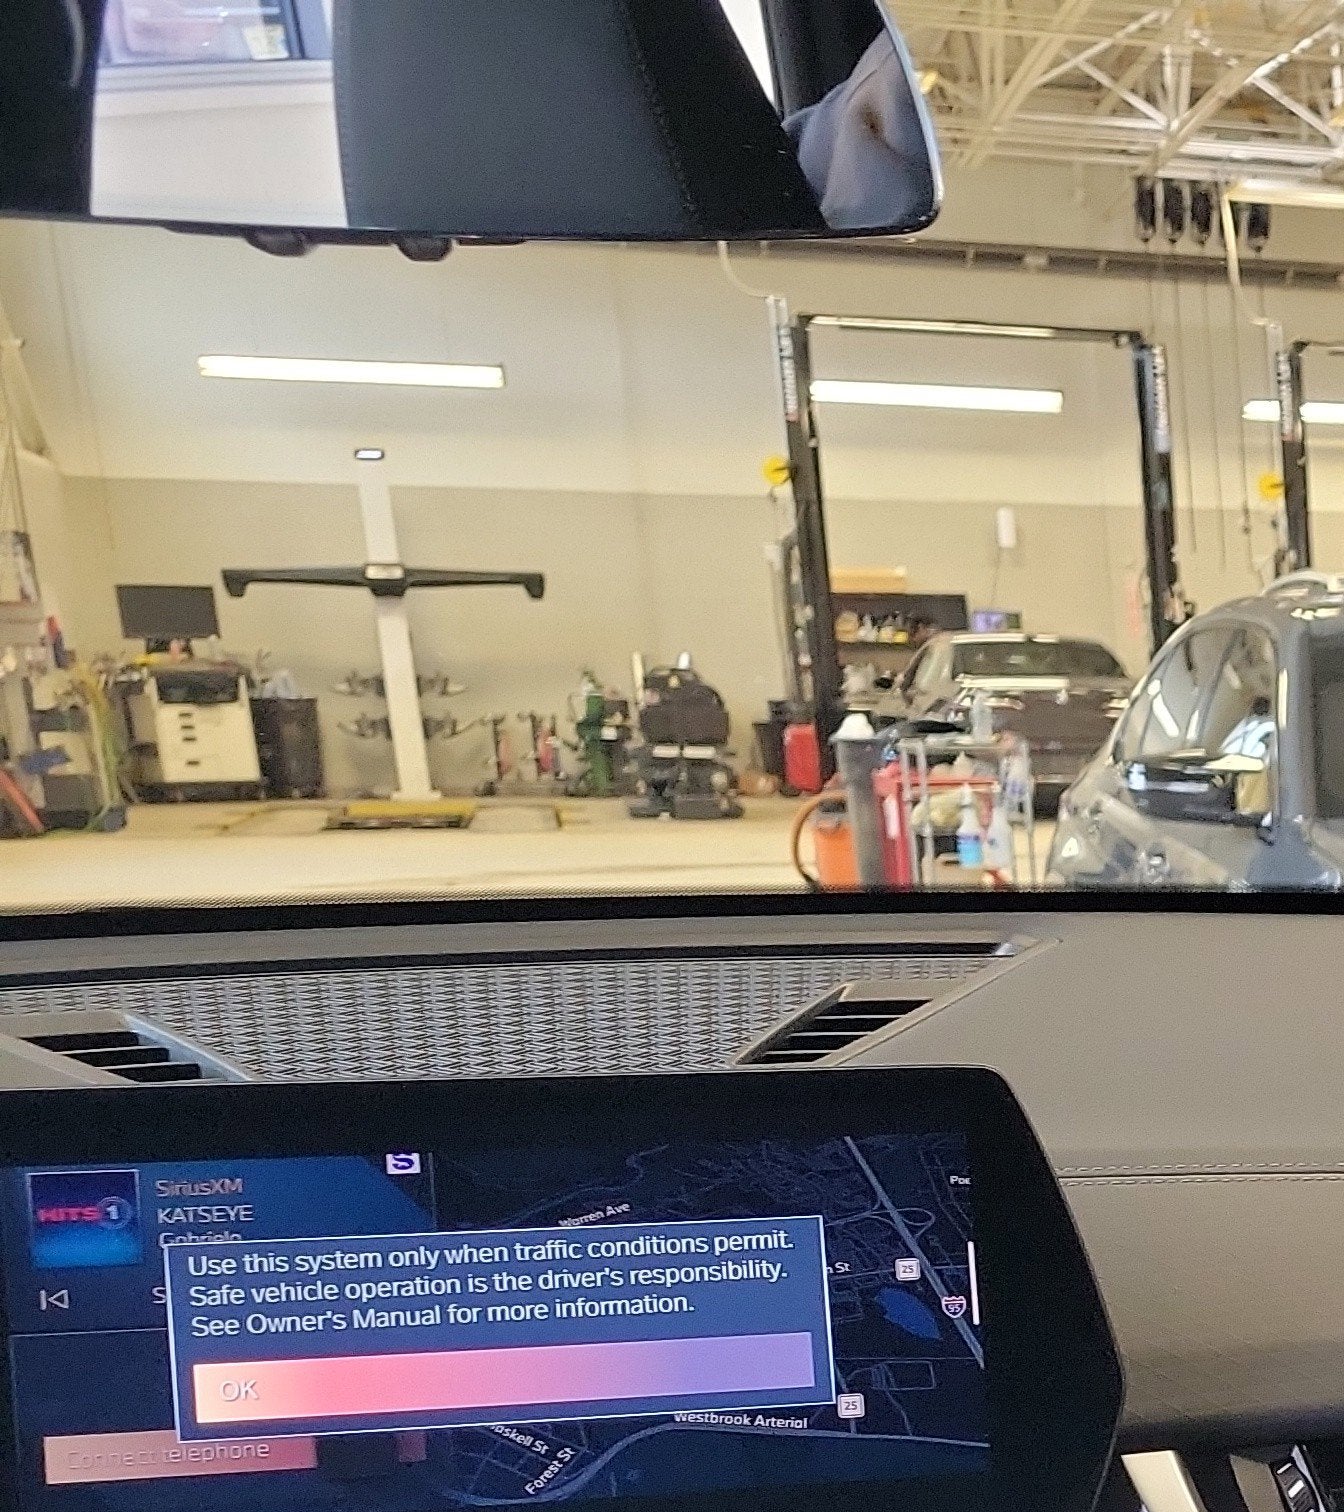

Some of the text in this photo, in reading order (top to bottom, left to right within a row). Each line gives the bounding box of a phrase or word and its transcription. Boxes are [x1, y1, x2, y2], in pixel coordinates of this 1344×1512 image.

[155, 1178, 244, 1198] SiriusXM
[37, 1204, 101, 1224] HITS
[157, 1204, 255, 1225] KATSEYE
[605, 1201, 631, 1217] Ave
[188, 1230, 795, 1276] Use this system only when traffic conditions permit.
[834, 1262, 851, 1274] St
[901, 1264, 914, 1275] 25
[189, 1284, 246, 1307] Safe
[251, 1280, 340, 1302] vehicle
[345, 1275, 462, 1304] operation
[467, 1273, 489, 1293] is
[493, 1271, 533, 1292] the
[538, 1267, 624, 1289] driver's
[629, 1260, 788, 1288] responsibility.
[191, 1294, 696, 1337] See Owner's Manual for more information.
[948, 1303, 961, 1313] 95
[220, 1380, 259, 1402] OK
[844, 1400, 858, 1412] 25
[674, 1412, 808, 1430] Westbrook Arterial
[490, 1425, 550, 1455] askell St
[162, 1442, 270, 1464] telephone
[524, 1447, 576, 1495] Forest St
